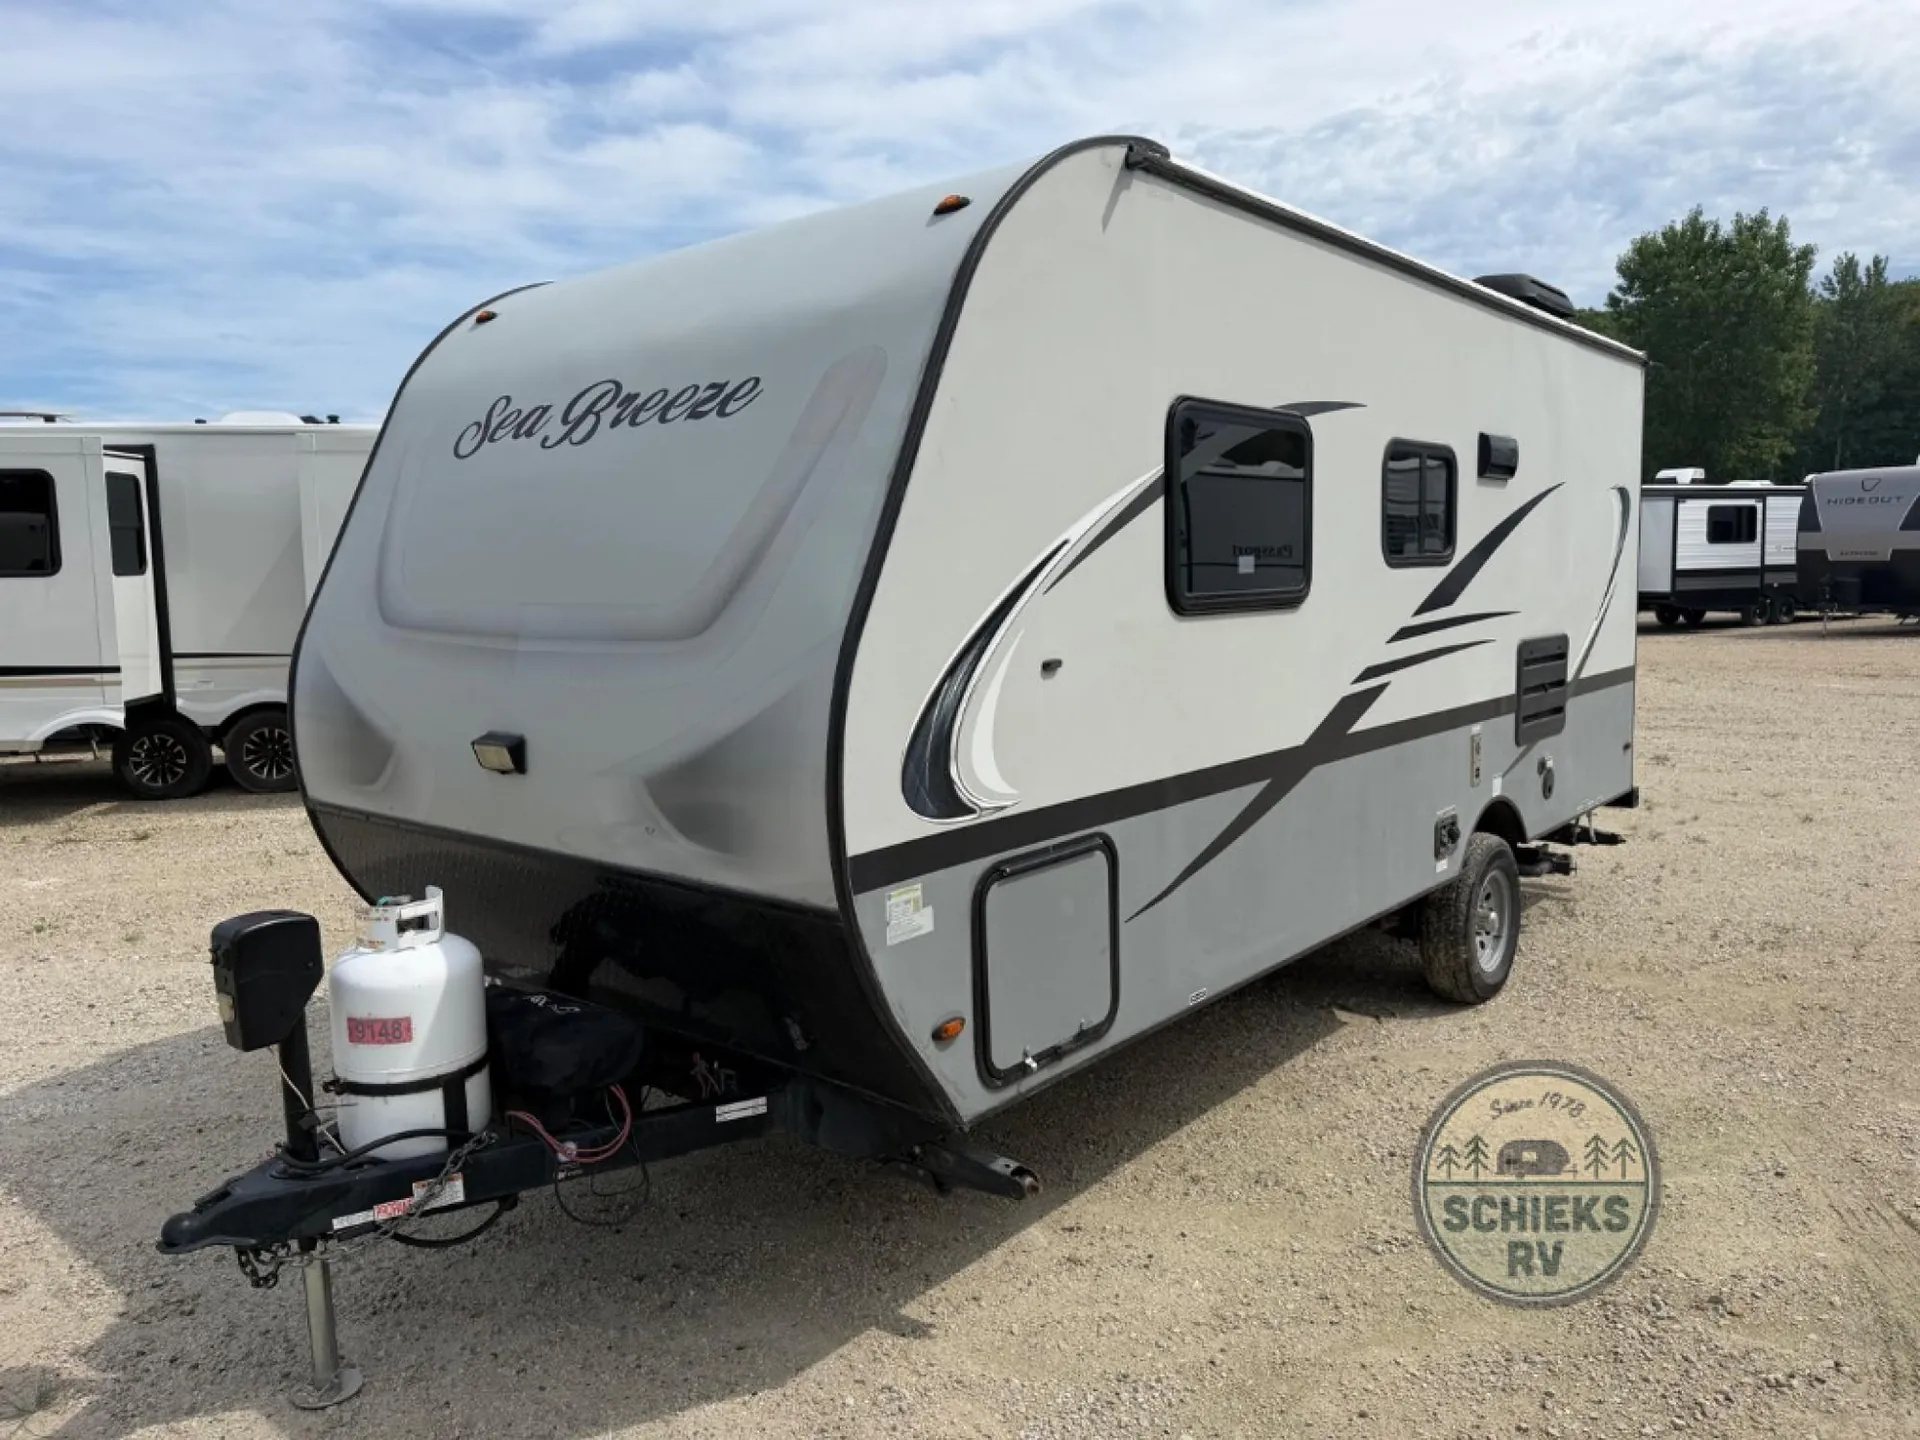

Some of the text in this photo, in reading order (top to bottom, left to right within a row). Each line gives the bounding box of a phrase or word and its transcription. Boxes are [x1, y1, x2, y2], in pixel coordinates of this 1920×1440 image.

[453, 376, 764, 460] Sea Breeze
[1827, 495, 1904, 506] HIDEOUT
